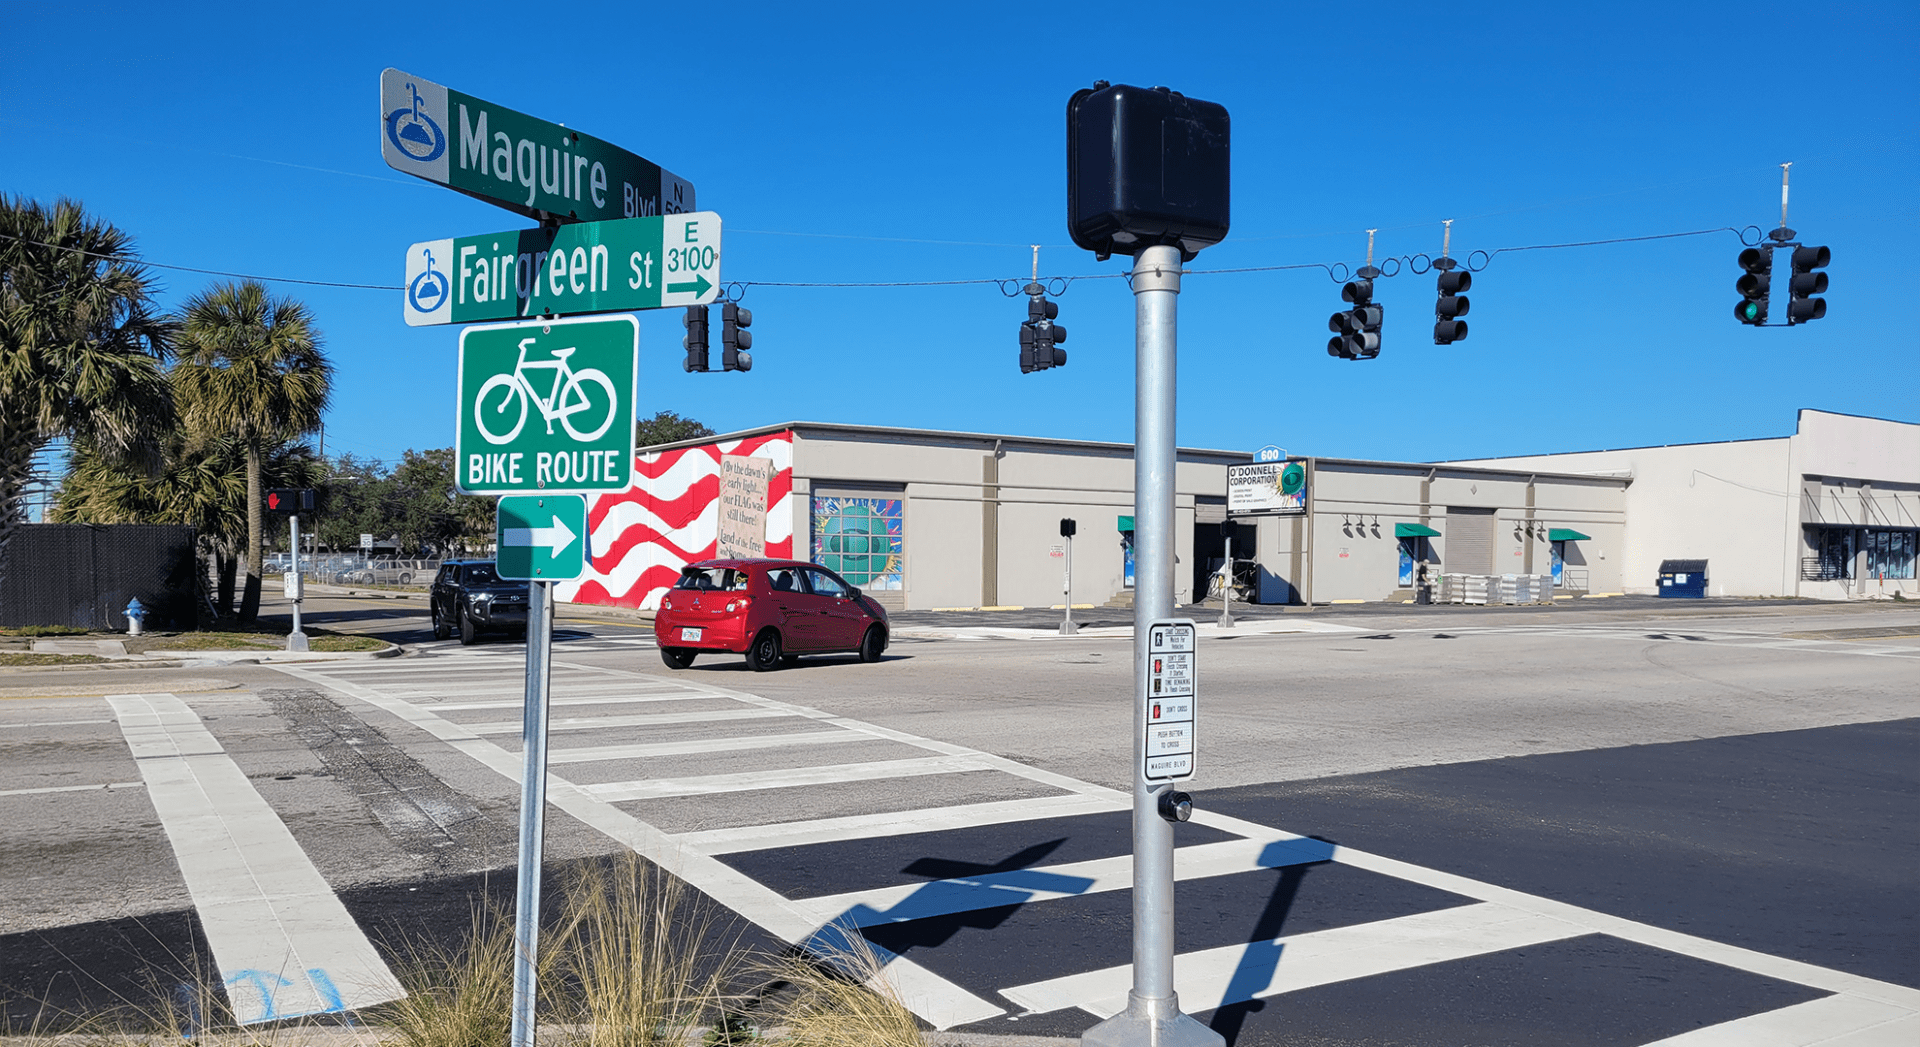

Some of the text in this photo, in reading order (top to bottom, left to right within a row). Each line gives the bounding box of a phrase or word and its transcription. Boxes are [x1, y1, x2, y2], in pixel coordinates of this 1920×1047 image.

[459, 104, 656, 218] Maguire Blvd
[674, 182, 683, 204] N
[685, 221, 699, 243] E
[667, 245, 715, 273] 3100
[459, 243, 653, 316] Fairgreen St
[1261, 449, 1279, 461] 600
[468, 450, 620, 484] BIKE ROUTE
[734, 462, 744, 475] the
[1230, 465, 1277, 477] O'DONNELL
[727, 477, 741, 493] early
[1230, 475, 1277, 486] CORPORATION
[723, 494, 764, 513] our FLAG was
[726, 509, 738, 522] still
[720, 529, 735, 545] Land
[749, 537, 762, 553] free
[1151, 761, 1172, 770] MAGUIRE
